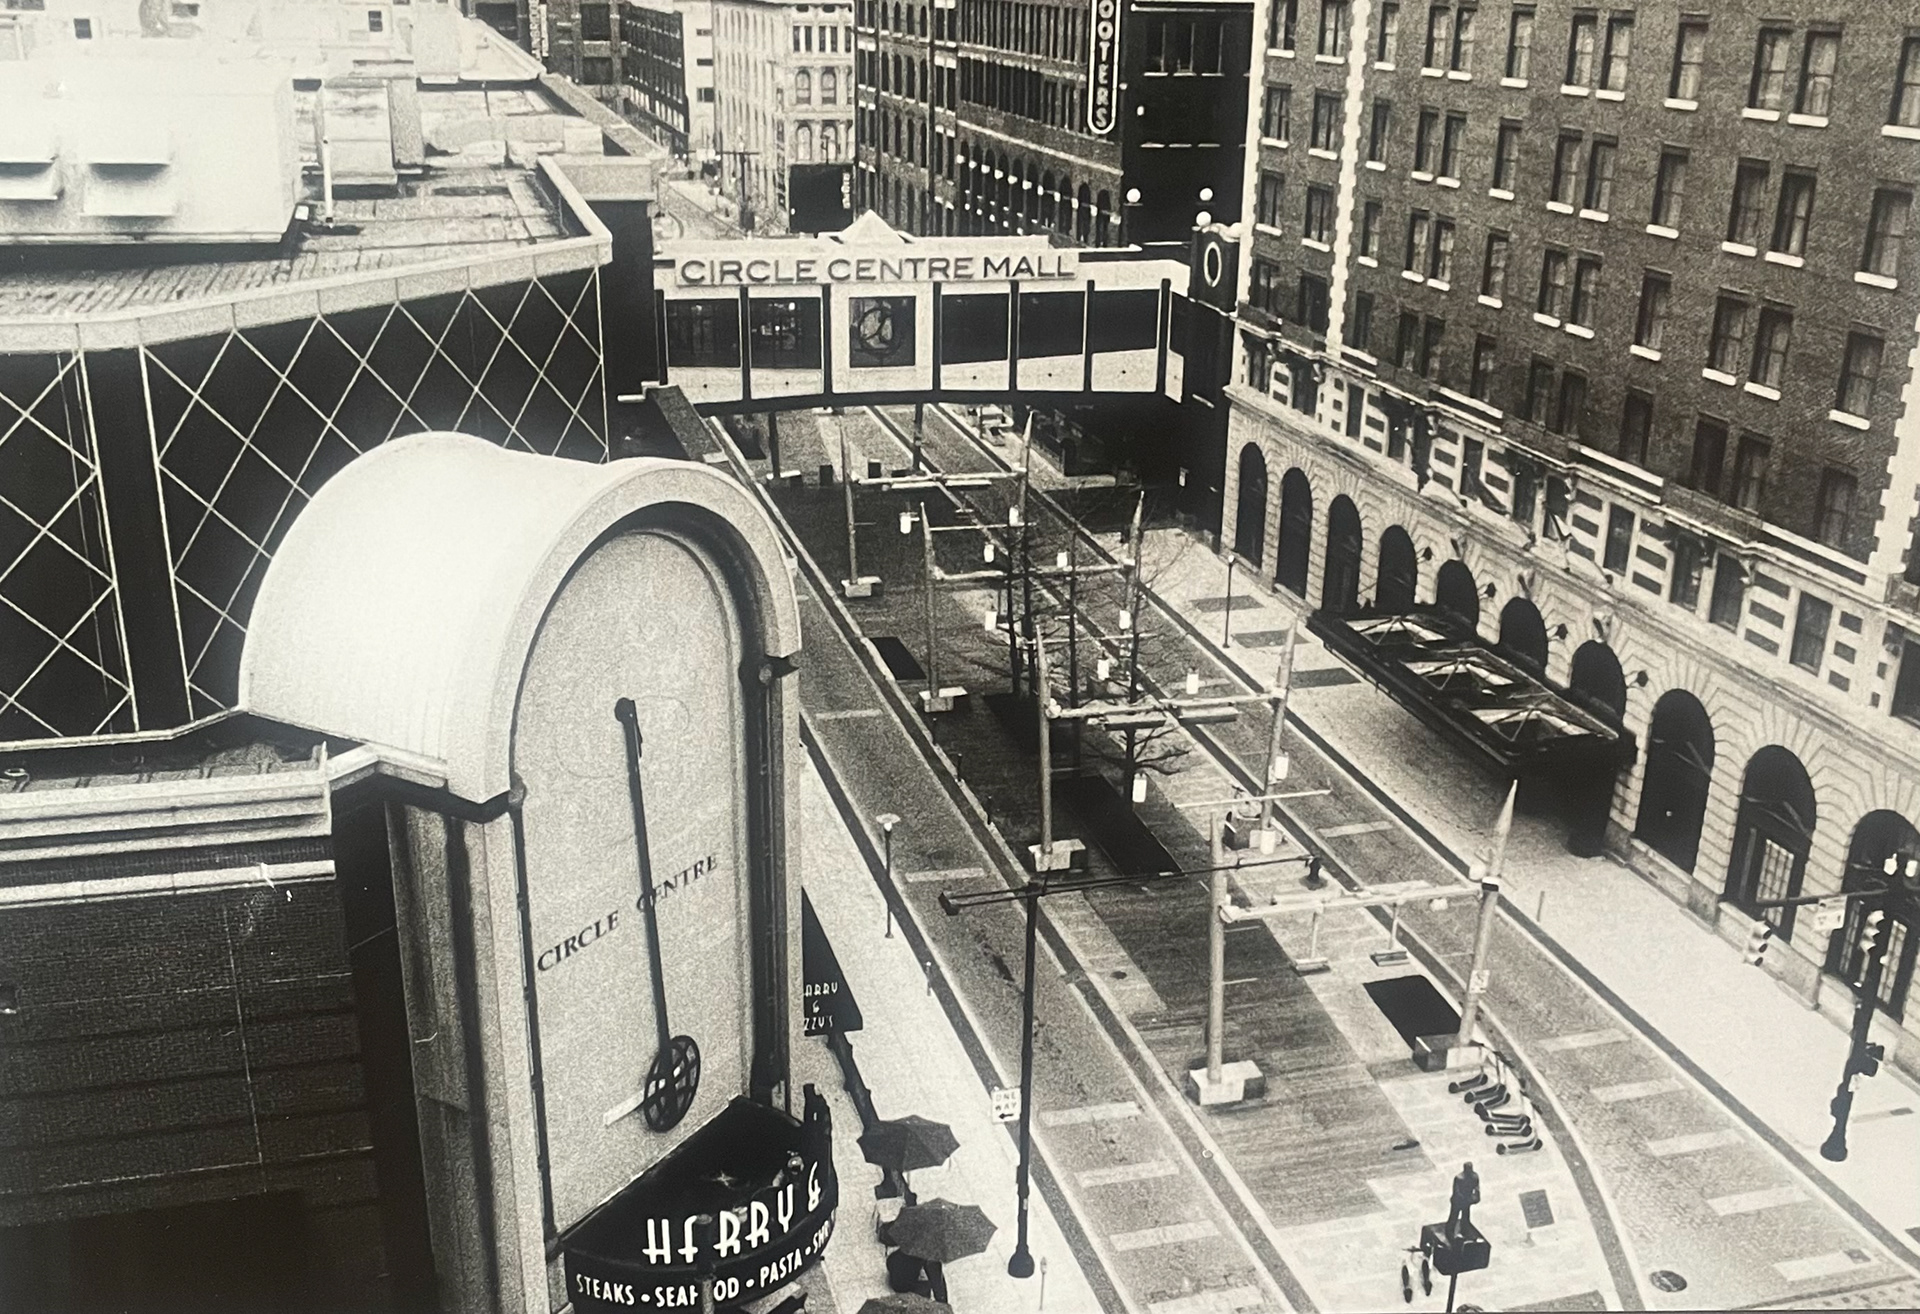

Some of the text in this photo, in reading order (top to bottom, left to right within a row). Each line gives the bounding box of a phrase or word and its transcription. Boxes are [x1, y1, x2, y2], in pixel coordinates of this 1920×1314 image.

[681, 255, 1075, 283] CIRCLE CENTRE MALL
[537, 910, 619, 972] CIRCLE
[807, 1161, 821, 1212] &
[576, 1273, 634, 1306] STEAKS
[655, 1277, 739, 1307] SEAFOD
[760, 1248, 802, 1288] PASTA
